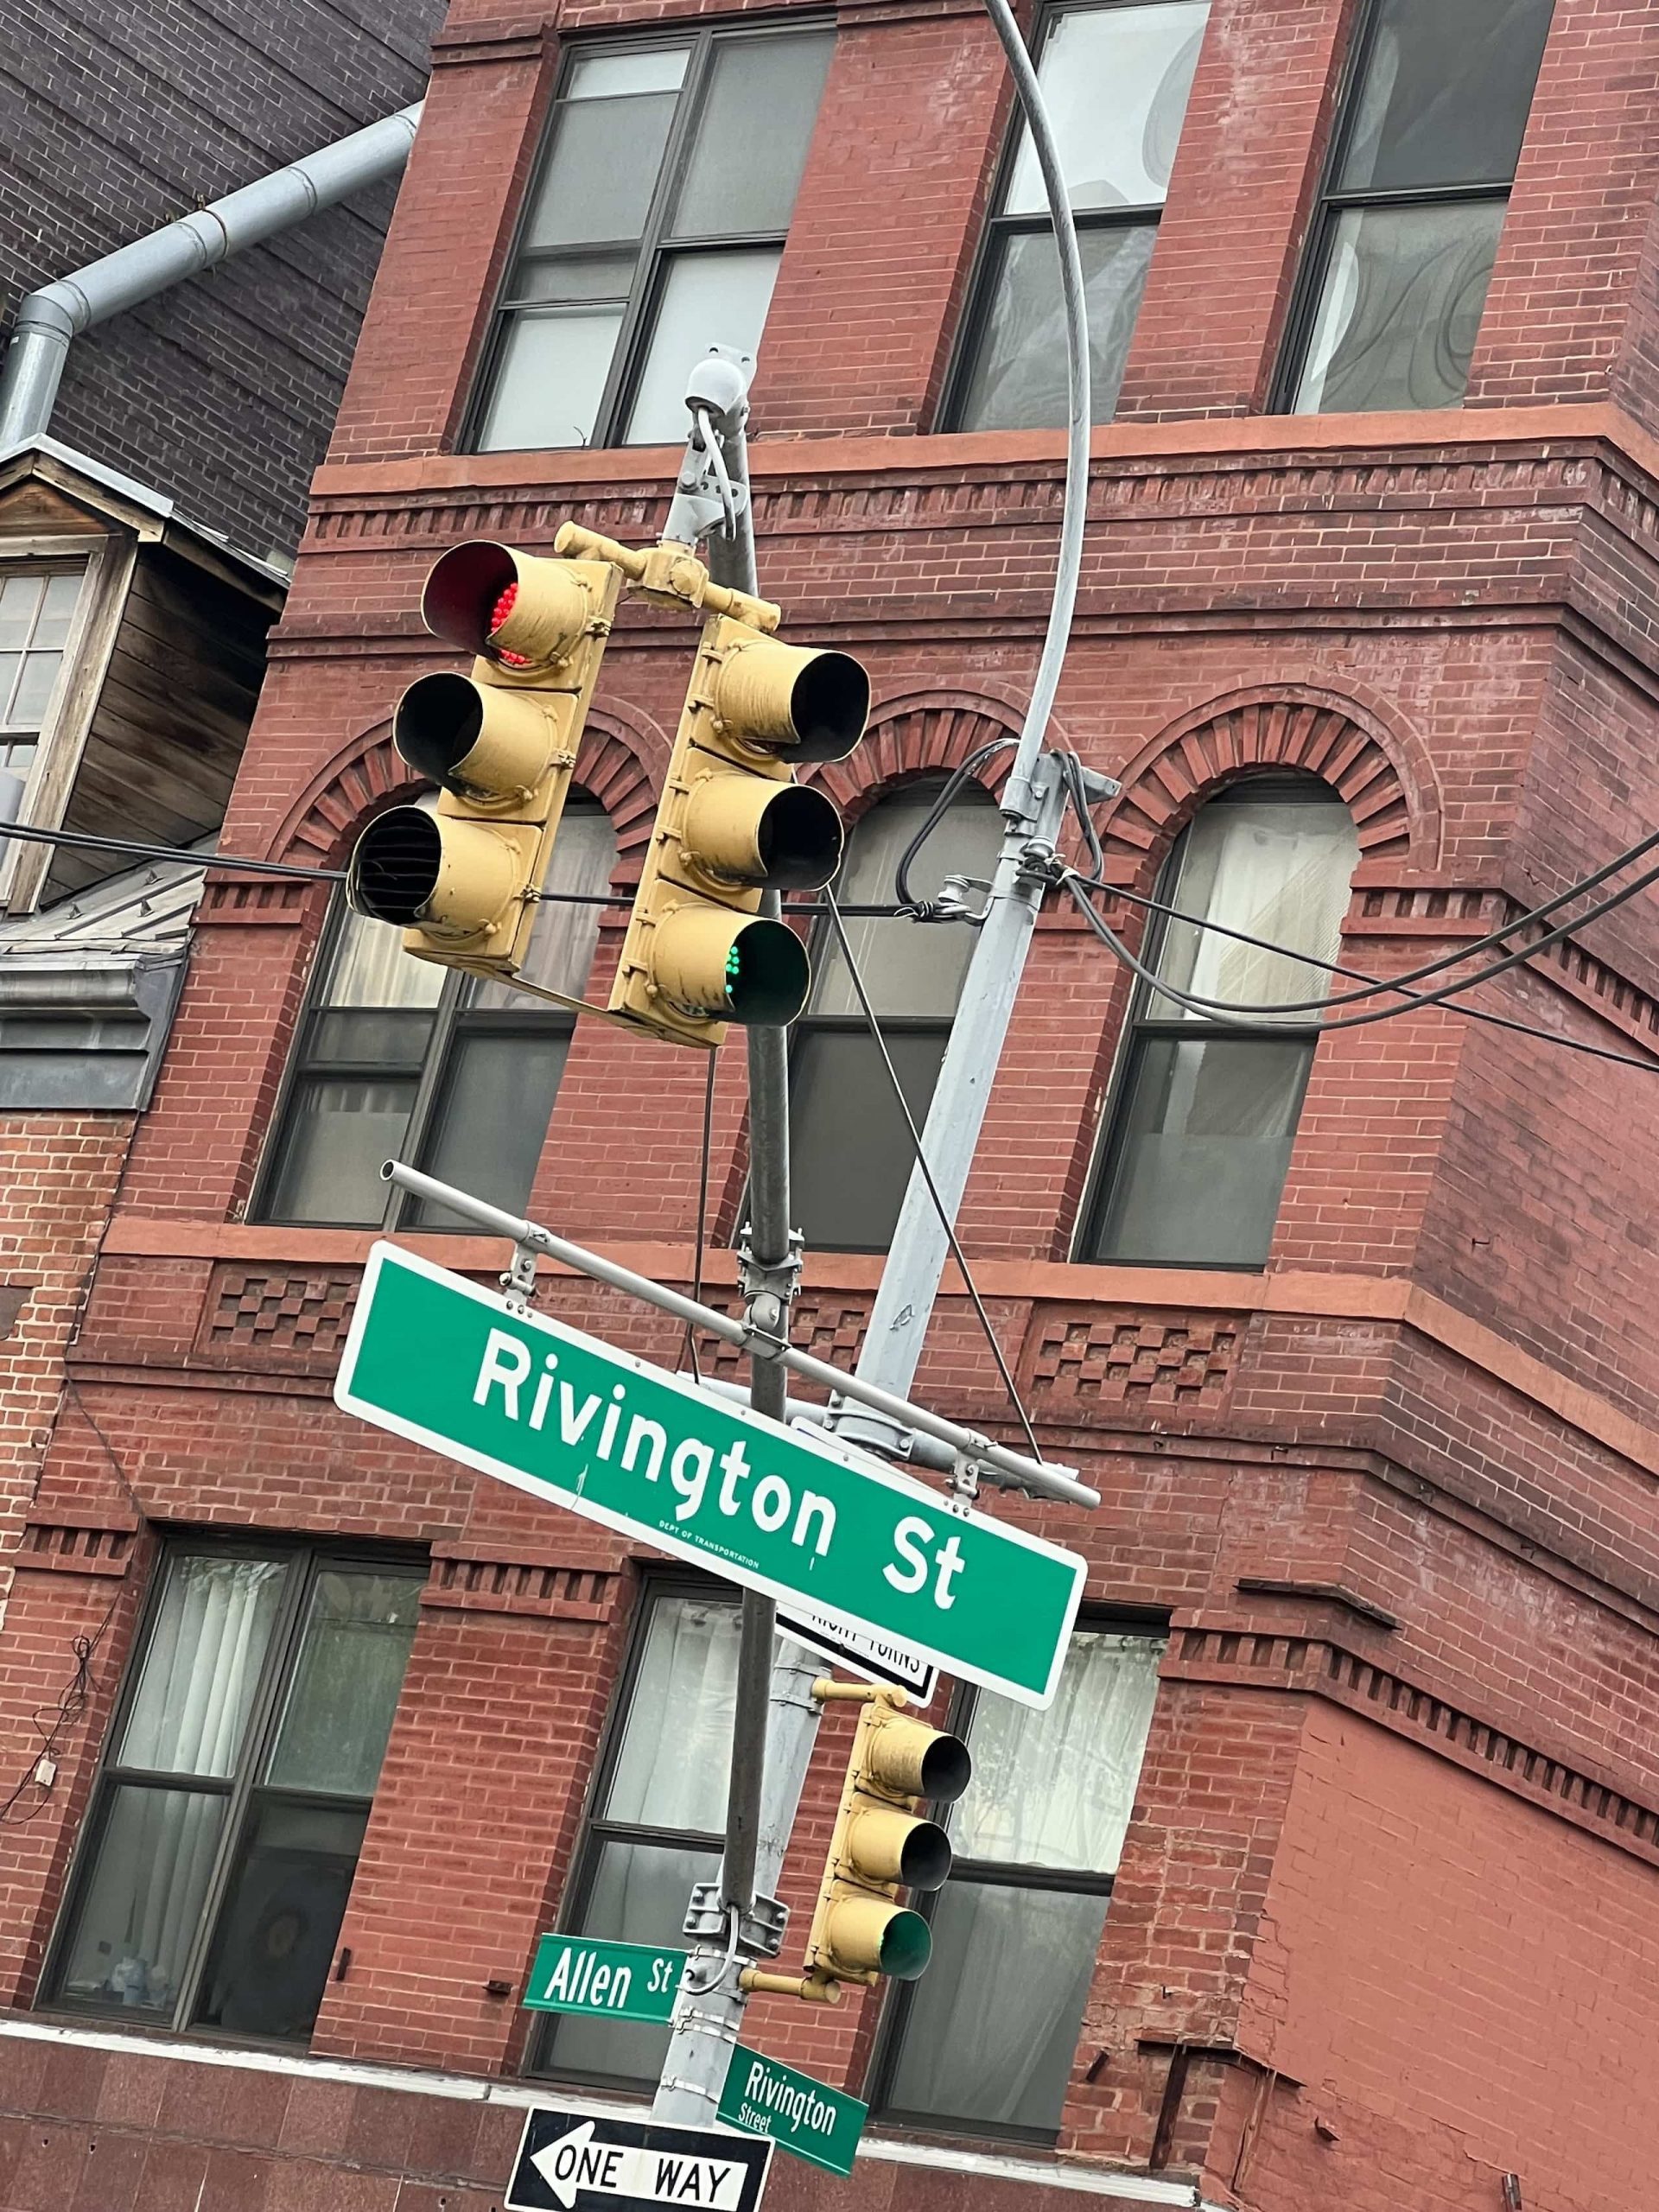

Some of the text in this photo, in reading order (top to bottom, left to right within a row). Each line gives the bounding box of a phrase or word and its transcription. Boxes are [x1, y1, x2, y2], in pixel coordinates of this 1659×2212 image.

[473, 1327, 965, 1611] Rivington St
[658, 1519, 760, 1569] DEPT OF TRANSPORTATION
[543, 1947, 673, 2009] Allen St
[737, 2101, 772, 2135] Street
[743, 2060, 837, 2137] Rivington
[554, 2144, 732, 2202] ONE WAY
